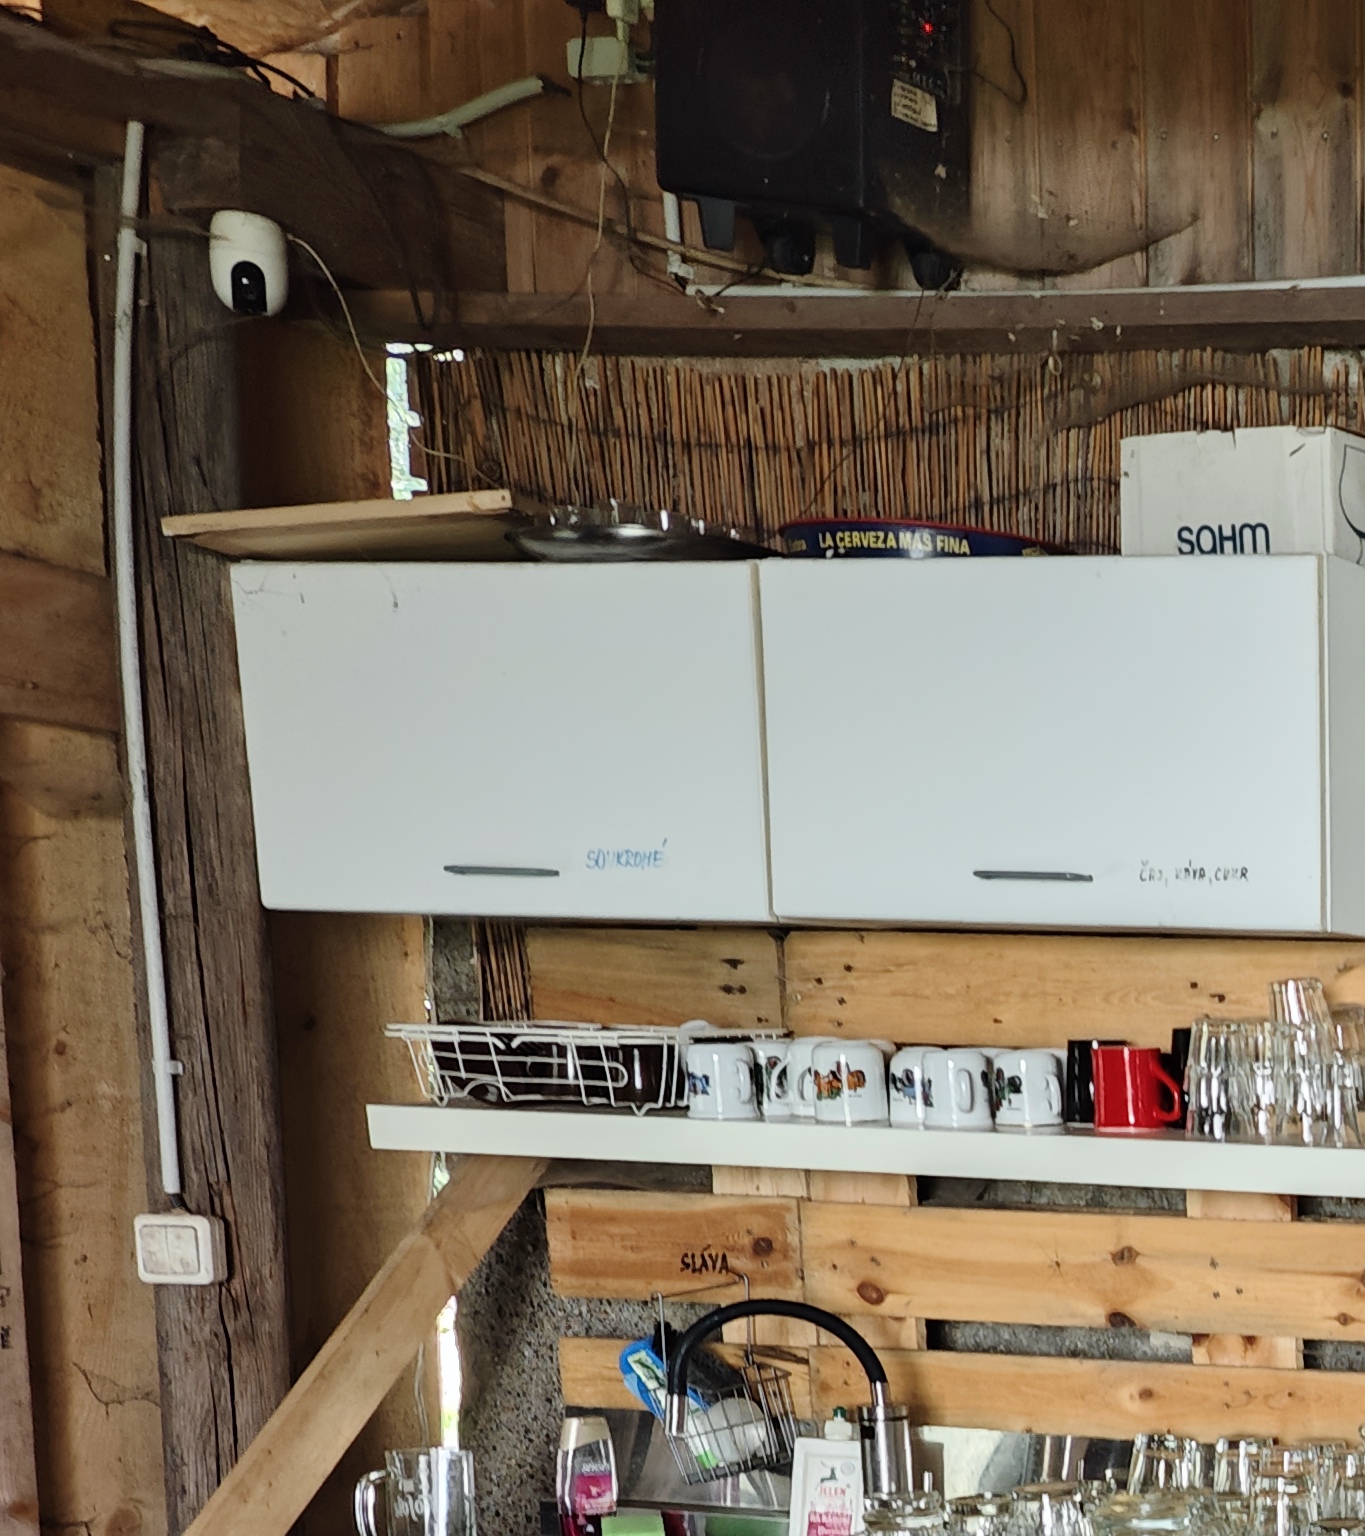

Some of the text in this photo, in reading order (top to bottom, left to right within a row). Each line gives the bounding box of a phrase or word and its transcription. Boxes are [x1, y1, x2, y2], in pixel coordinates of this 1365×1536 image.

[818, 532, 833, 548] LA
[836, 531, 897, 550] CERVEZA
[936, 534, 970, 555] FINA
